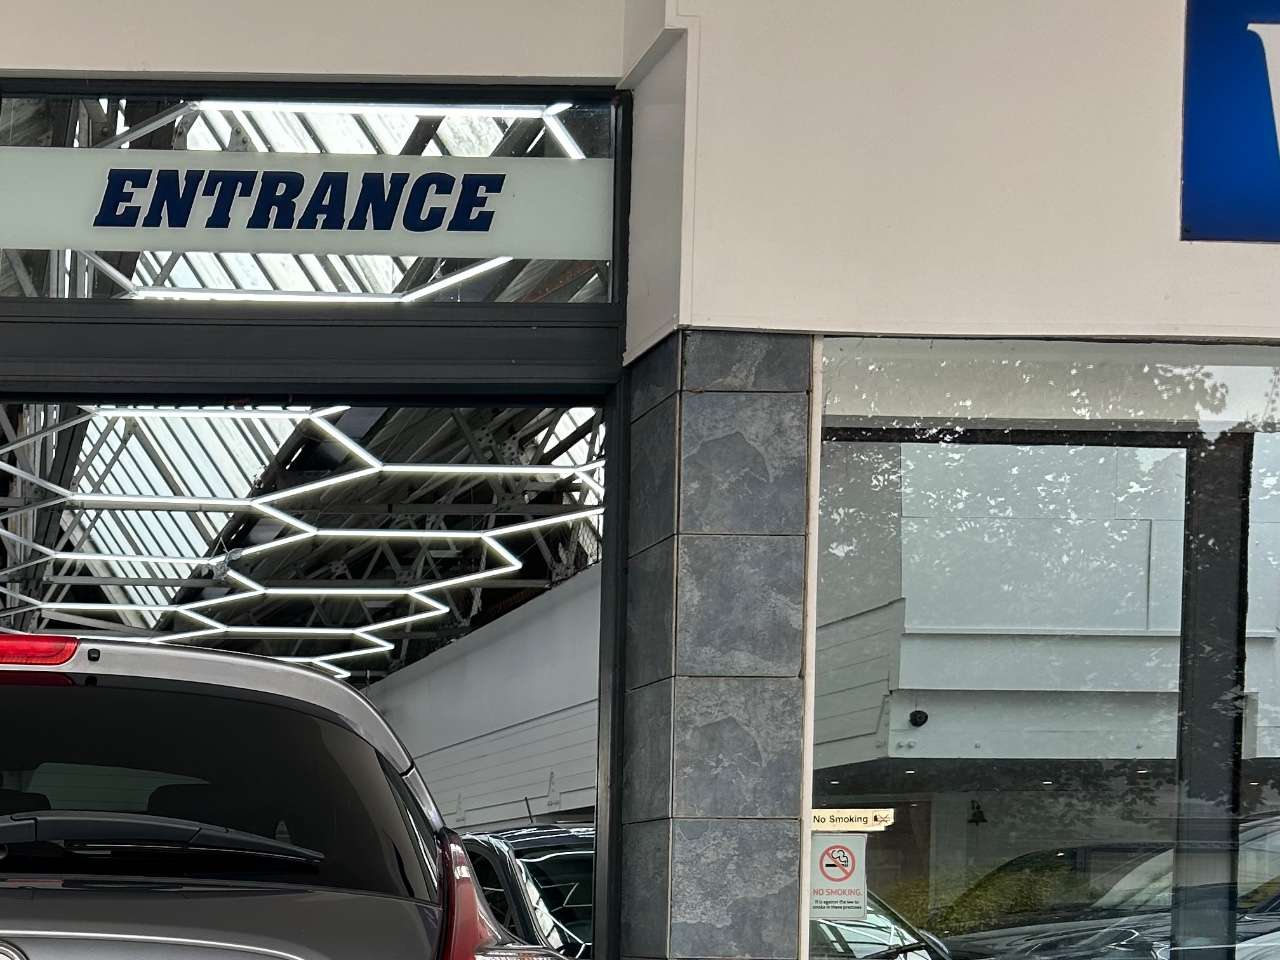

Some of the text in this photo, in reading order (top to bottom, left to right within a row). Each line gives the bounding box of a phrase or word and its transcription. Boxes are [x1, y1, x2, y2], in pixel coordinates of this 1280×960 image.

[93, 169, 506, 232] ENTRANCE
[813, 815, 869, 825] No Smoking
